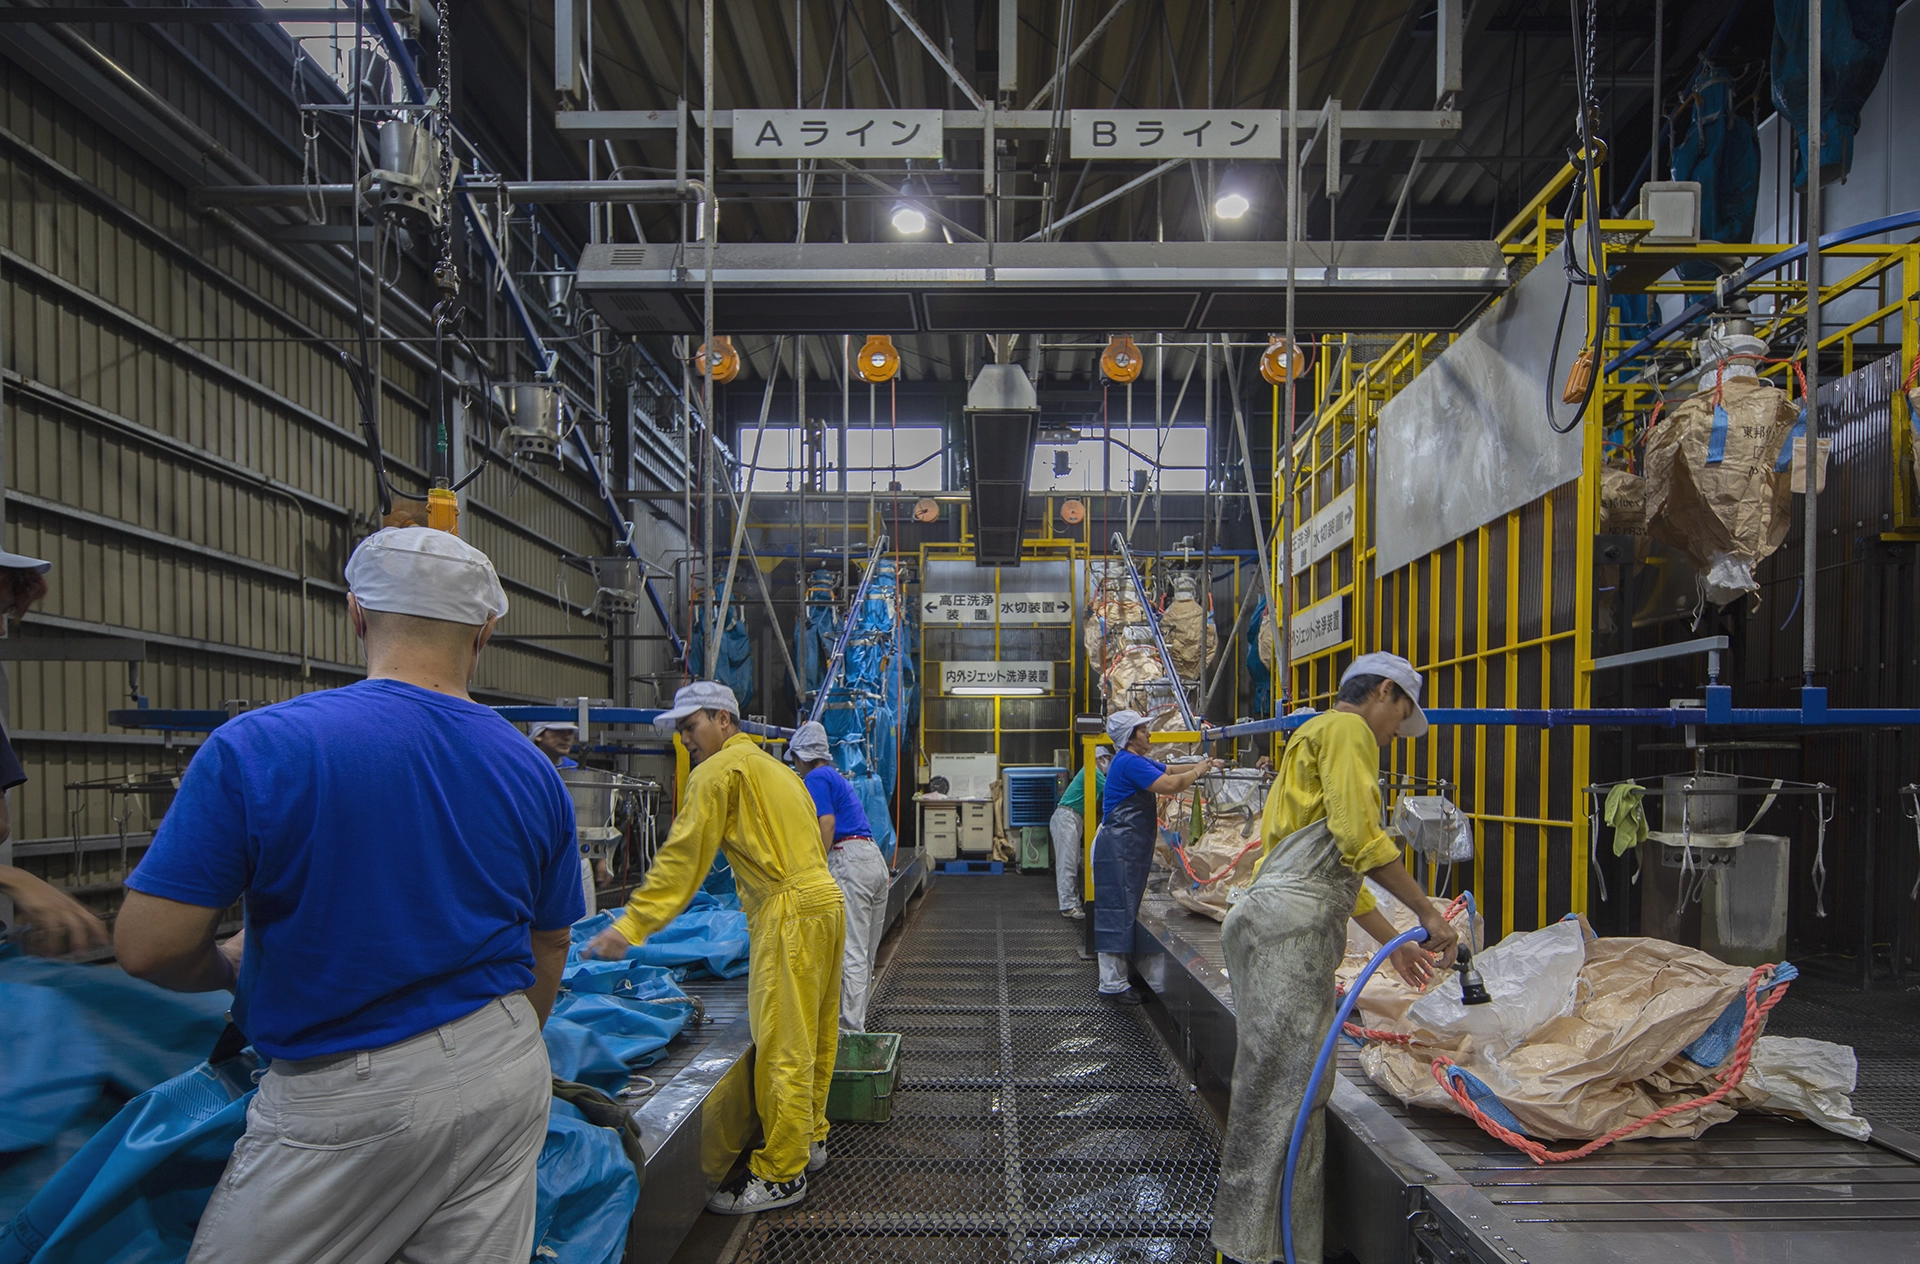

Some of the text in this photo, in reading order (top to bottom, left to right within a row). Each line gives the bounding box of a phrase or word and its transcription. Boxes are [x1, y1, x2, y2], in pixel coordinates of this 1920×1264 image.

[755, 120, 921, 147] Aライン
[1092, 120, 1259, 147] Bライン
[1313, 510, 1344, 548] 水切装置
[939, 594, 994, 607] 高圧洗浄
[1000, 601, 1055, 614] 水切装置
[946, 669, 1049, 683] 内外ジェット洗浄装置
